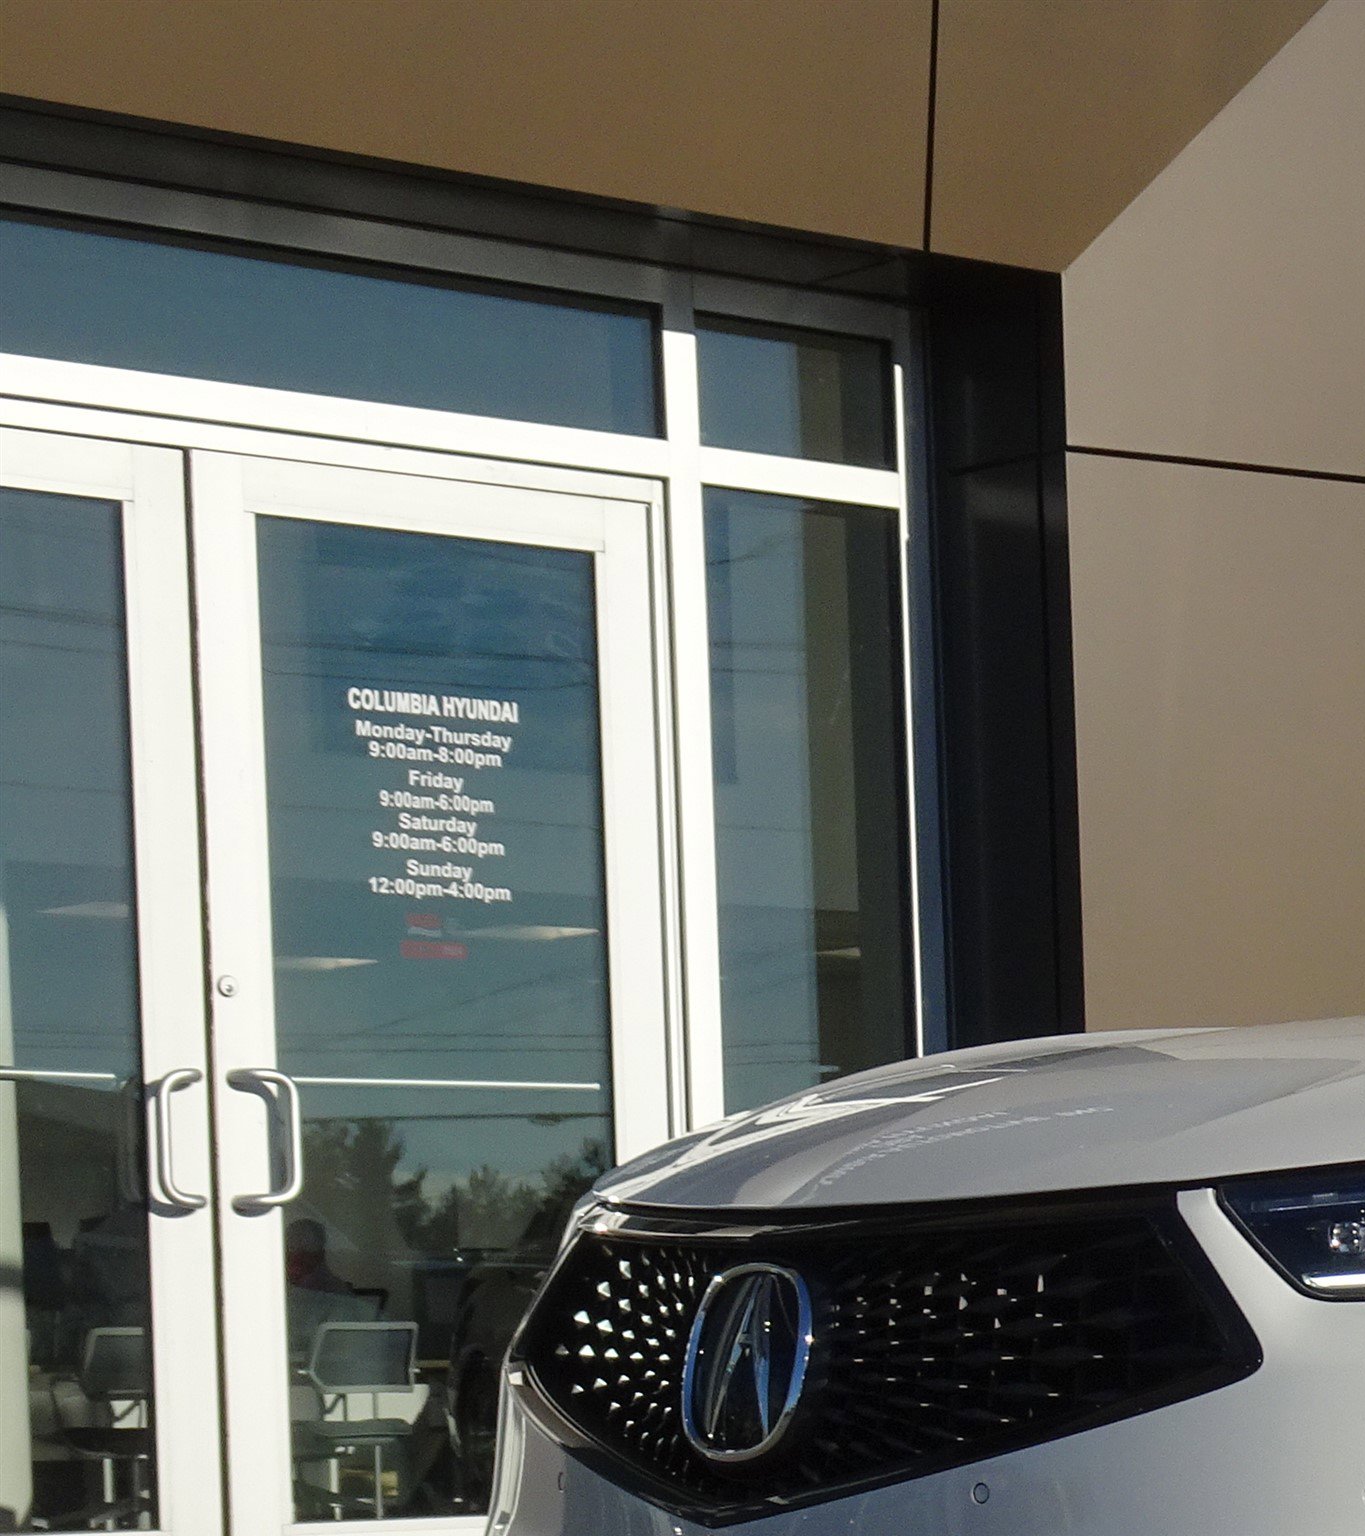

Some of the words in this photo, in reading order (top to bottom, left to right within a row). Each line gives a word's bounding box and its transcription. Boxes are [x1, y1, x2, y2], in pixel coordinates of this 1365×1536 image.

[348, 687, 440, 716] COLUMBIA
[442, 696, 519, 723] HYUNDAI
[355, 719, 512, 752] Monday-Thursday
[369, 740, 502, 768] 9:00am-8:00pm
[408, 769, 464, 793] Friday
[379, 789, 494, 814] 9:00am-6:00pm
[398, 812, 477, 836] Saturday
[372, 831, 505, 858] 9:00am-6:00pm
[406, 859, 472, 882] Sunday
[368, 876, 512, 903] 12:00pm-4:00pm
